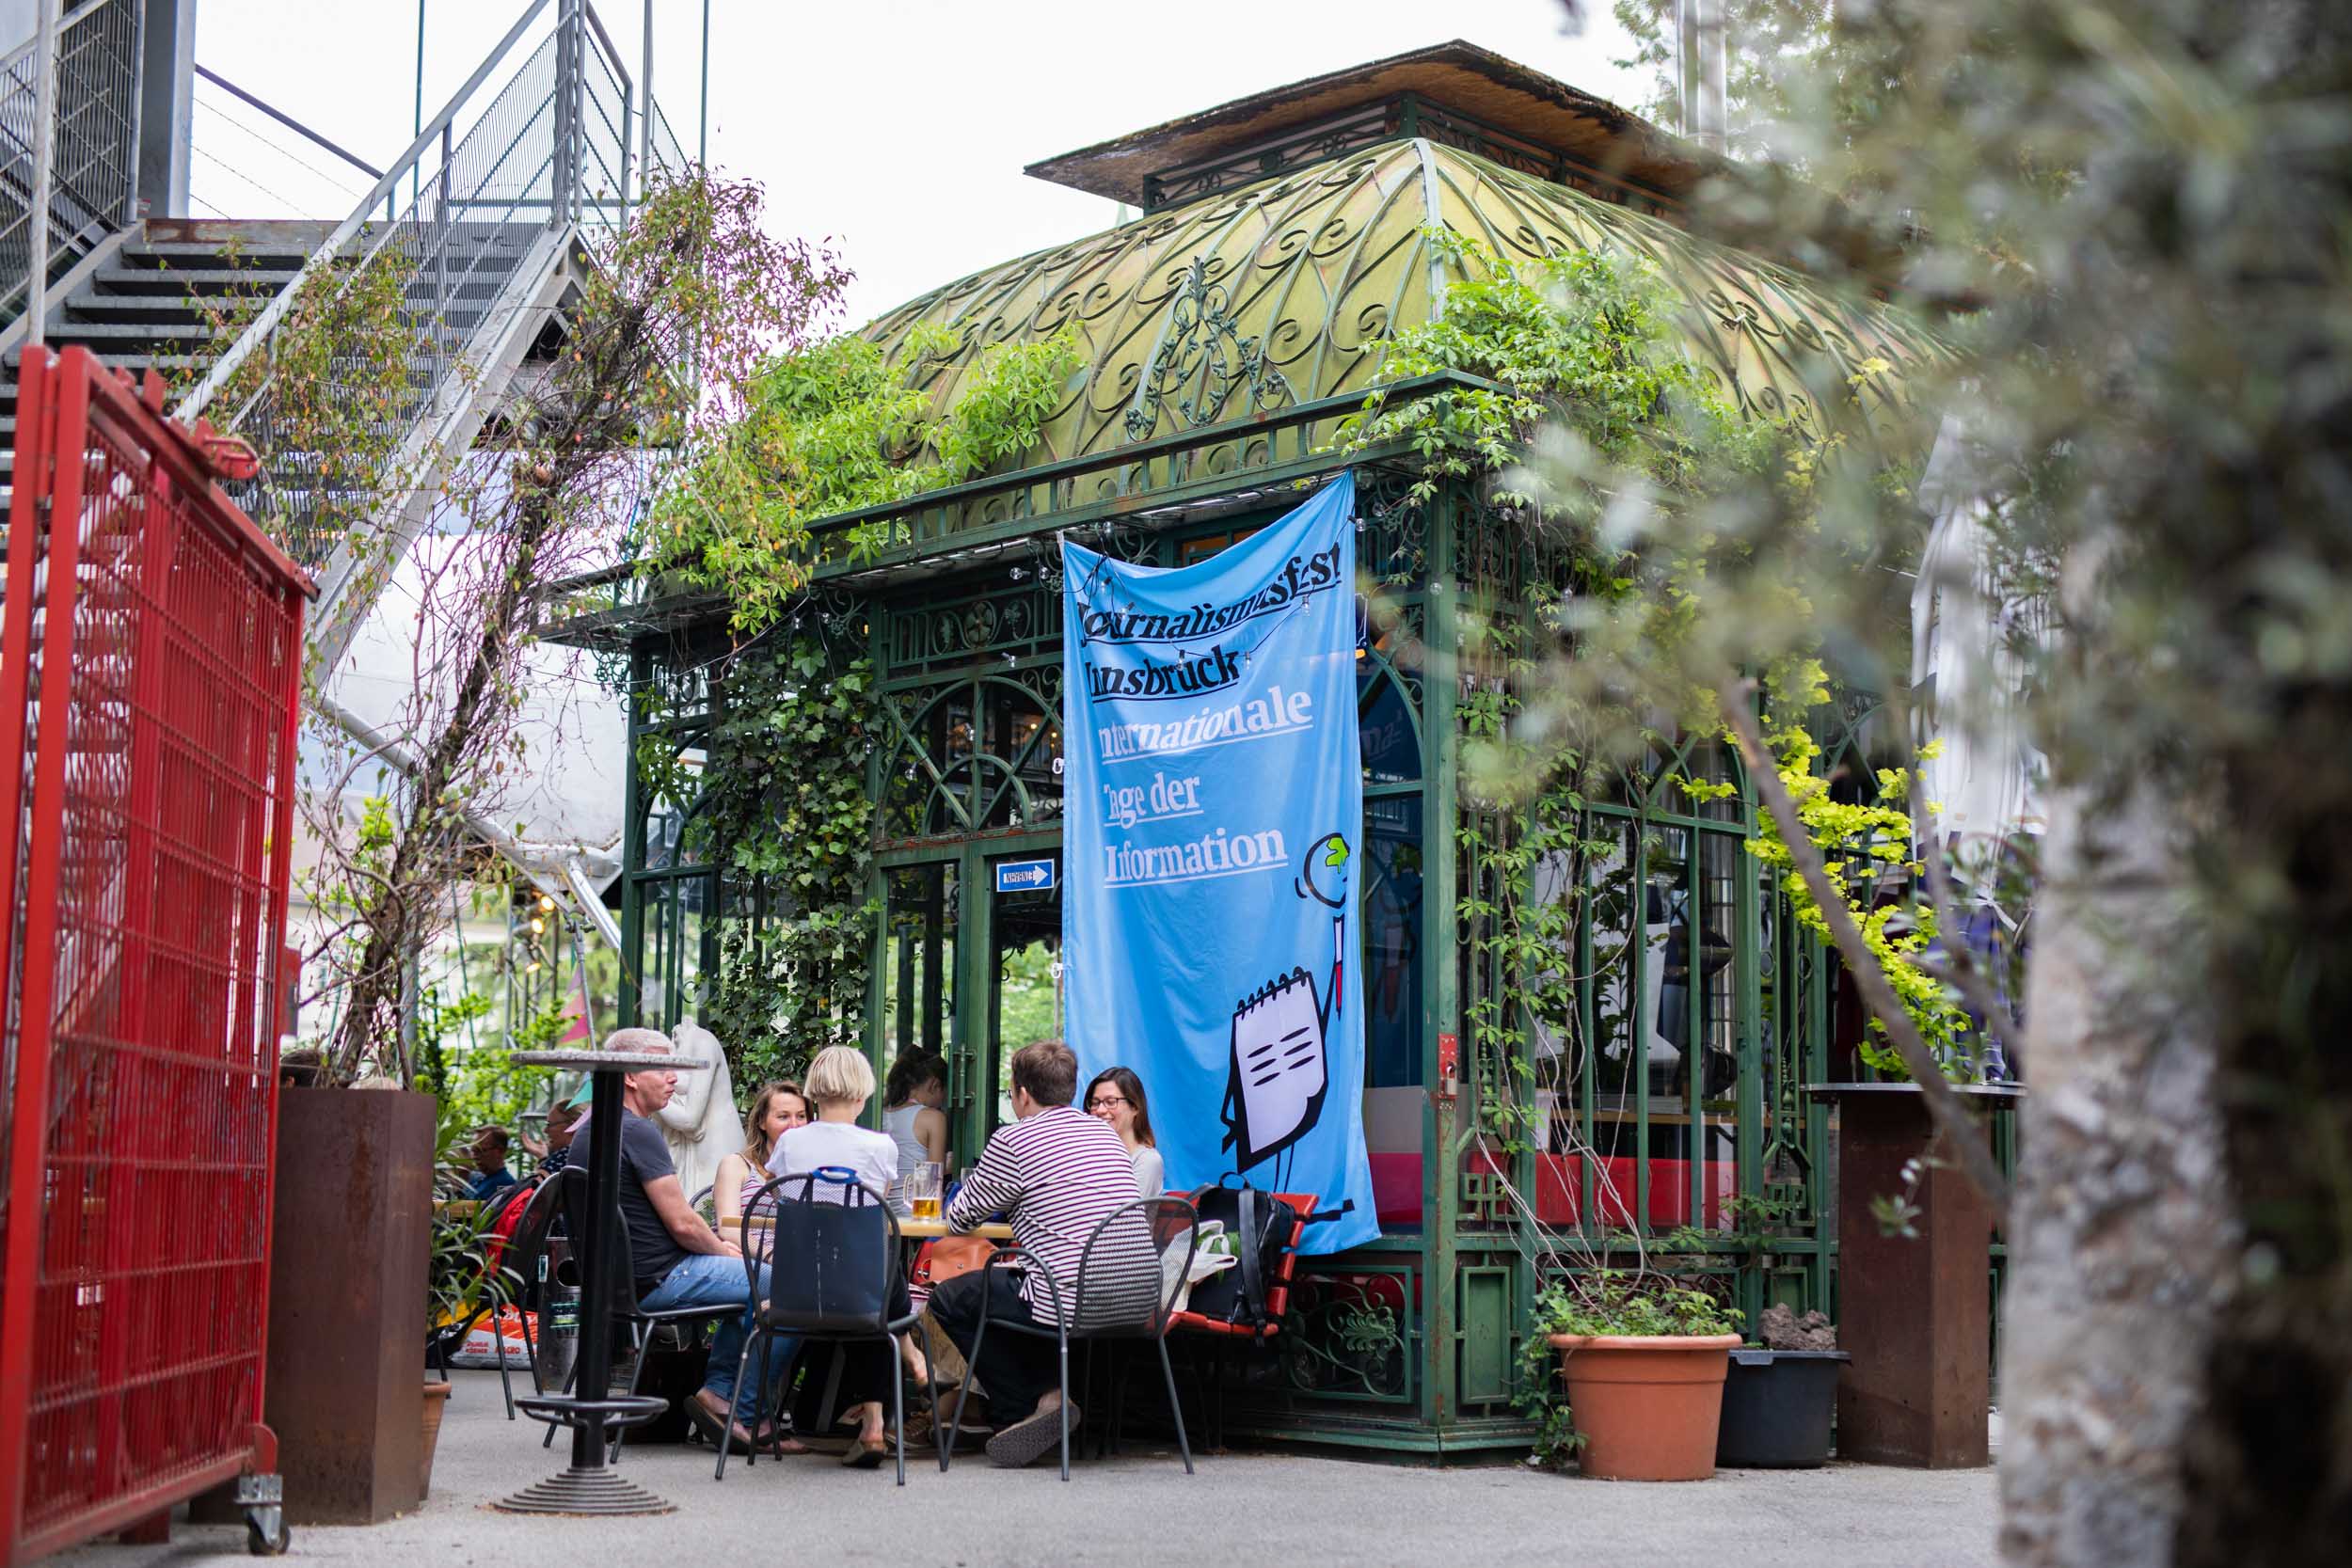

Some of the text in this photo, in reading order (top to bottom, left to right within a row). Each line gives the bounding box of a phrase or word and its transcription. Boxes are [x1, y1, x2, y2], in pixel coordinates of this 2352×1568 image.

[1098, 685, 1313, 758] nternationale
[1104, 772, 1200, 830] age der
